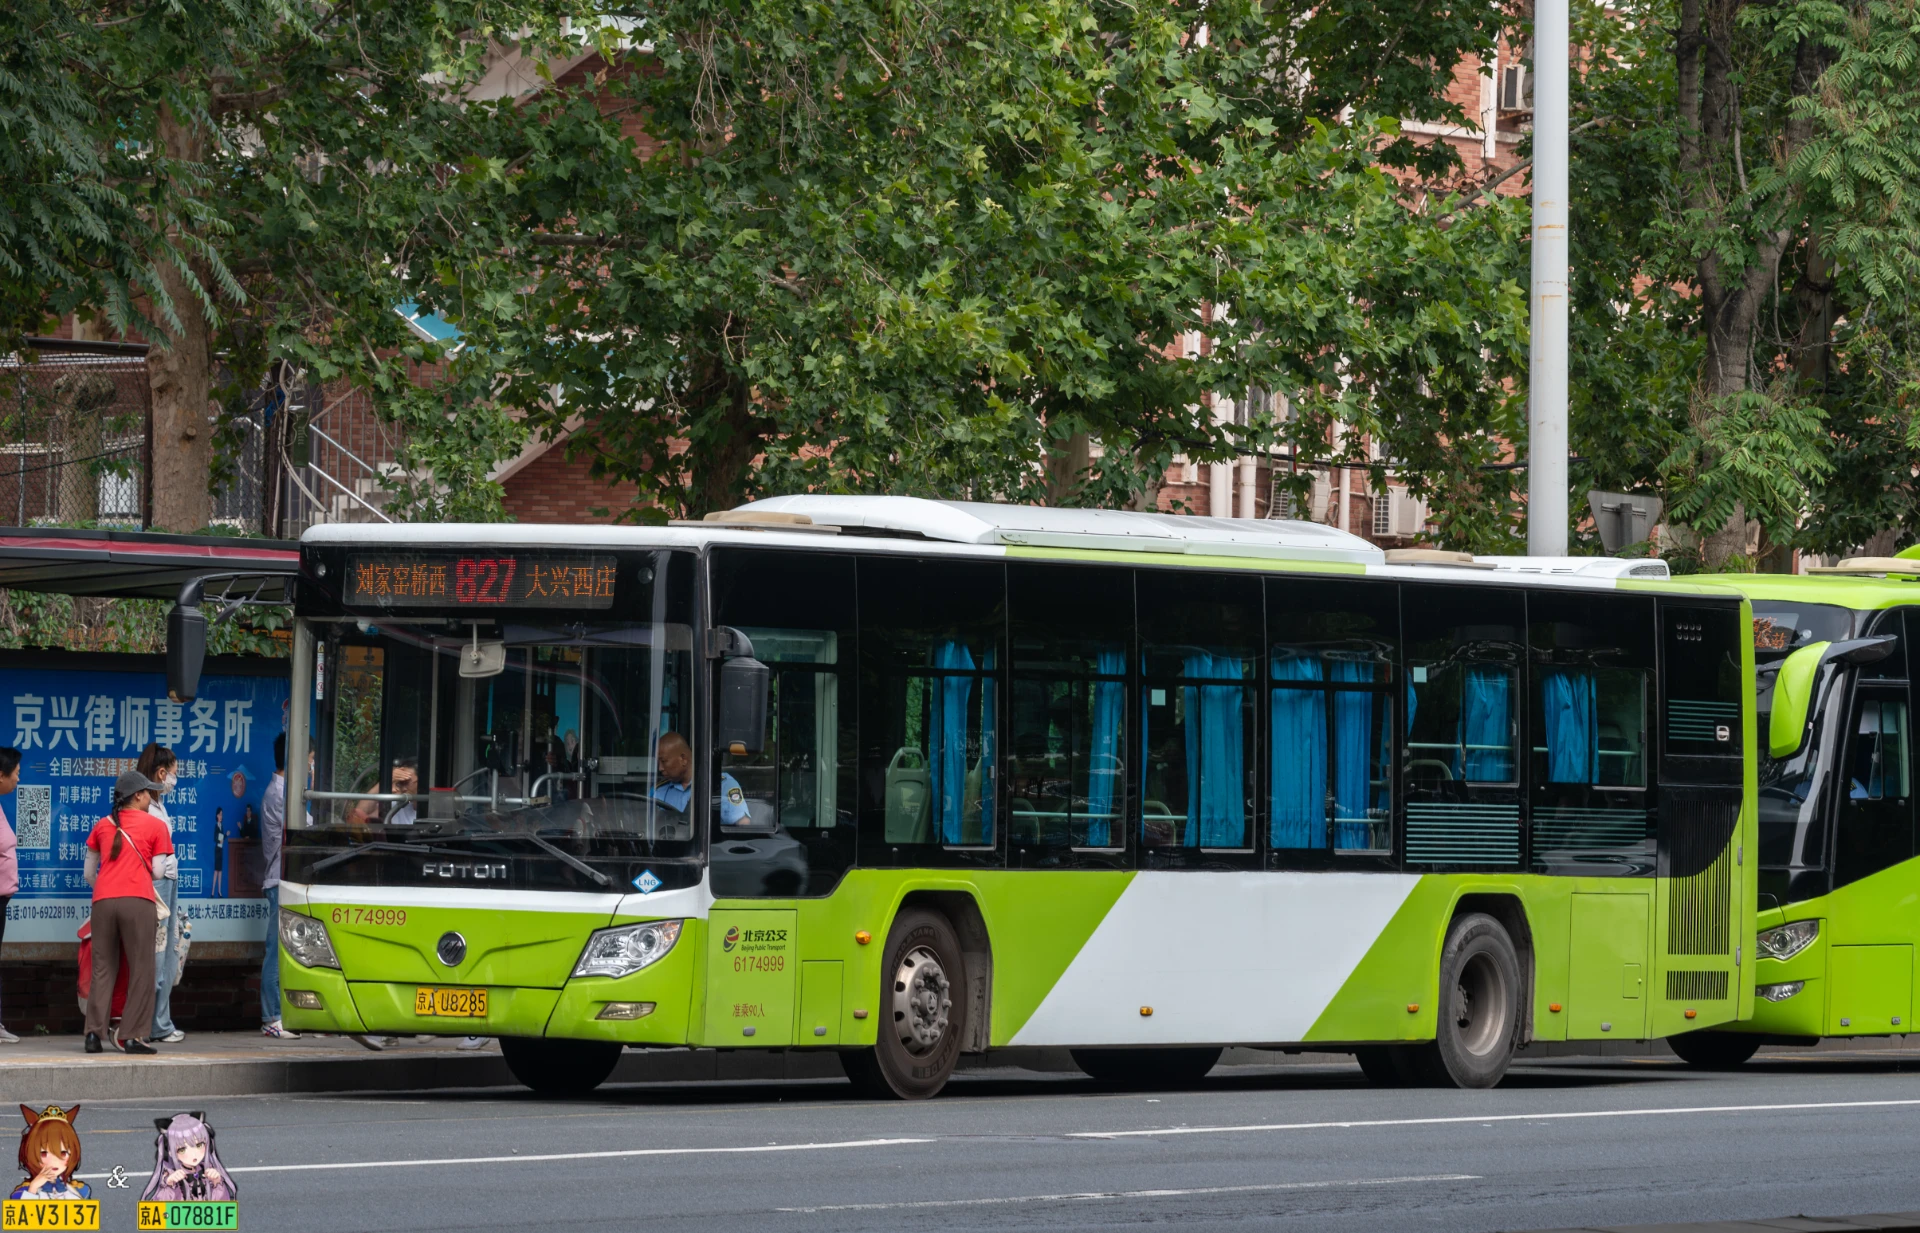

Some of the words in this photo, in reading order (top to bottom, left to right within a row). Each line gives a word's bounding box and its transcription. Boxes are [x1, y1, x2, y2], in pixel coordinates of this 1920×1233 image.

[355, 563, 447, 596] 刘家窑桥西
[455, 559, 516, 602] 827
[525, 564, 617, 598] 大兴西庄
[12, 693, 253, 754] 京兴律师事务所
[59, 786, 101, 804] 刑事辩护
[422, 864, 506, 879] FOTON
[638, 878, 656, 887] LNG
[332, 907, 407, 926] 6174999
[742, 929, 788, 942] 北京公交
[741, 944, 755, 953] Beijing
[755, 944, 766, 952] Public
[767, 944, 786, 952] Transport
[733, 955, 785, 973] 6174999
[733, 1003, 766, 1018] 准乘90人
